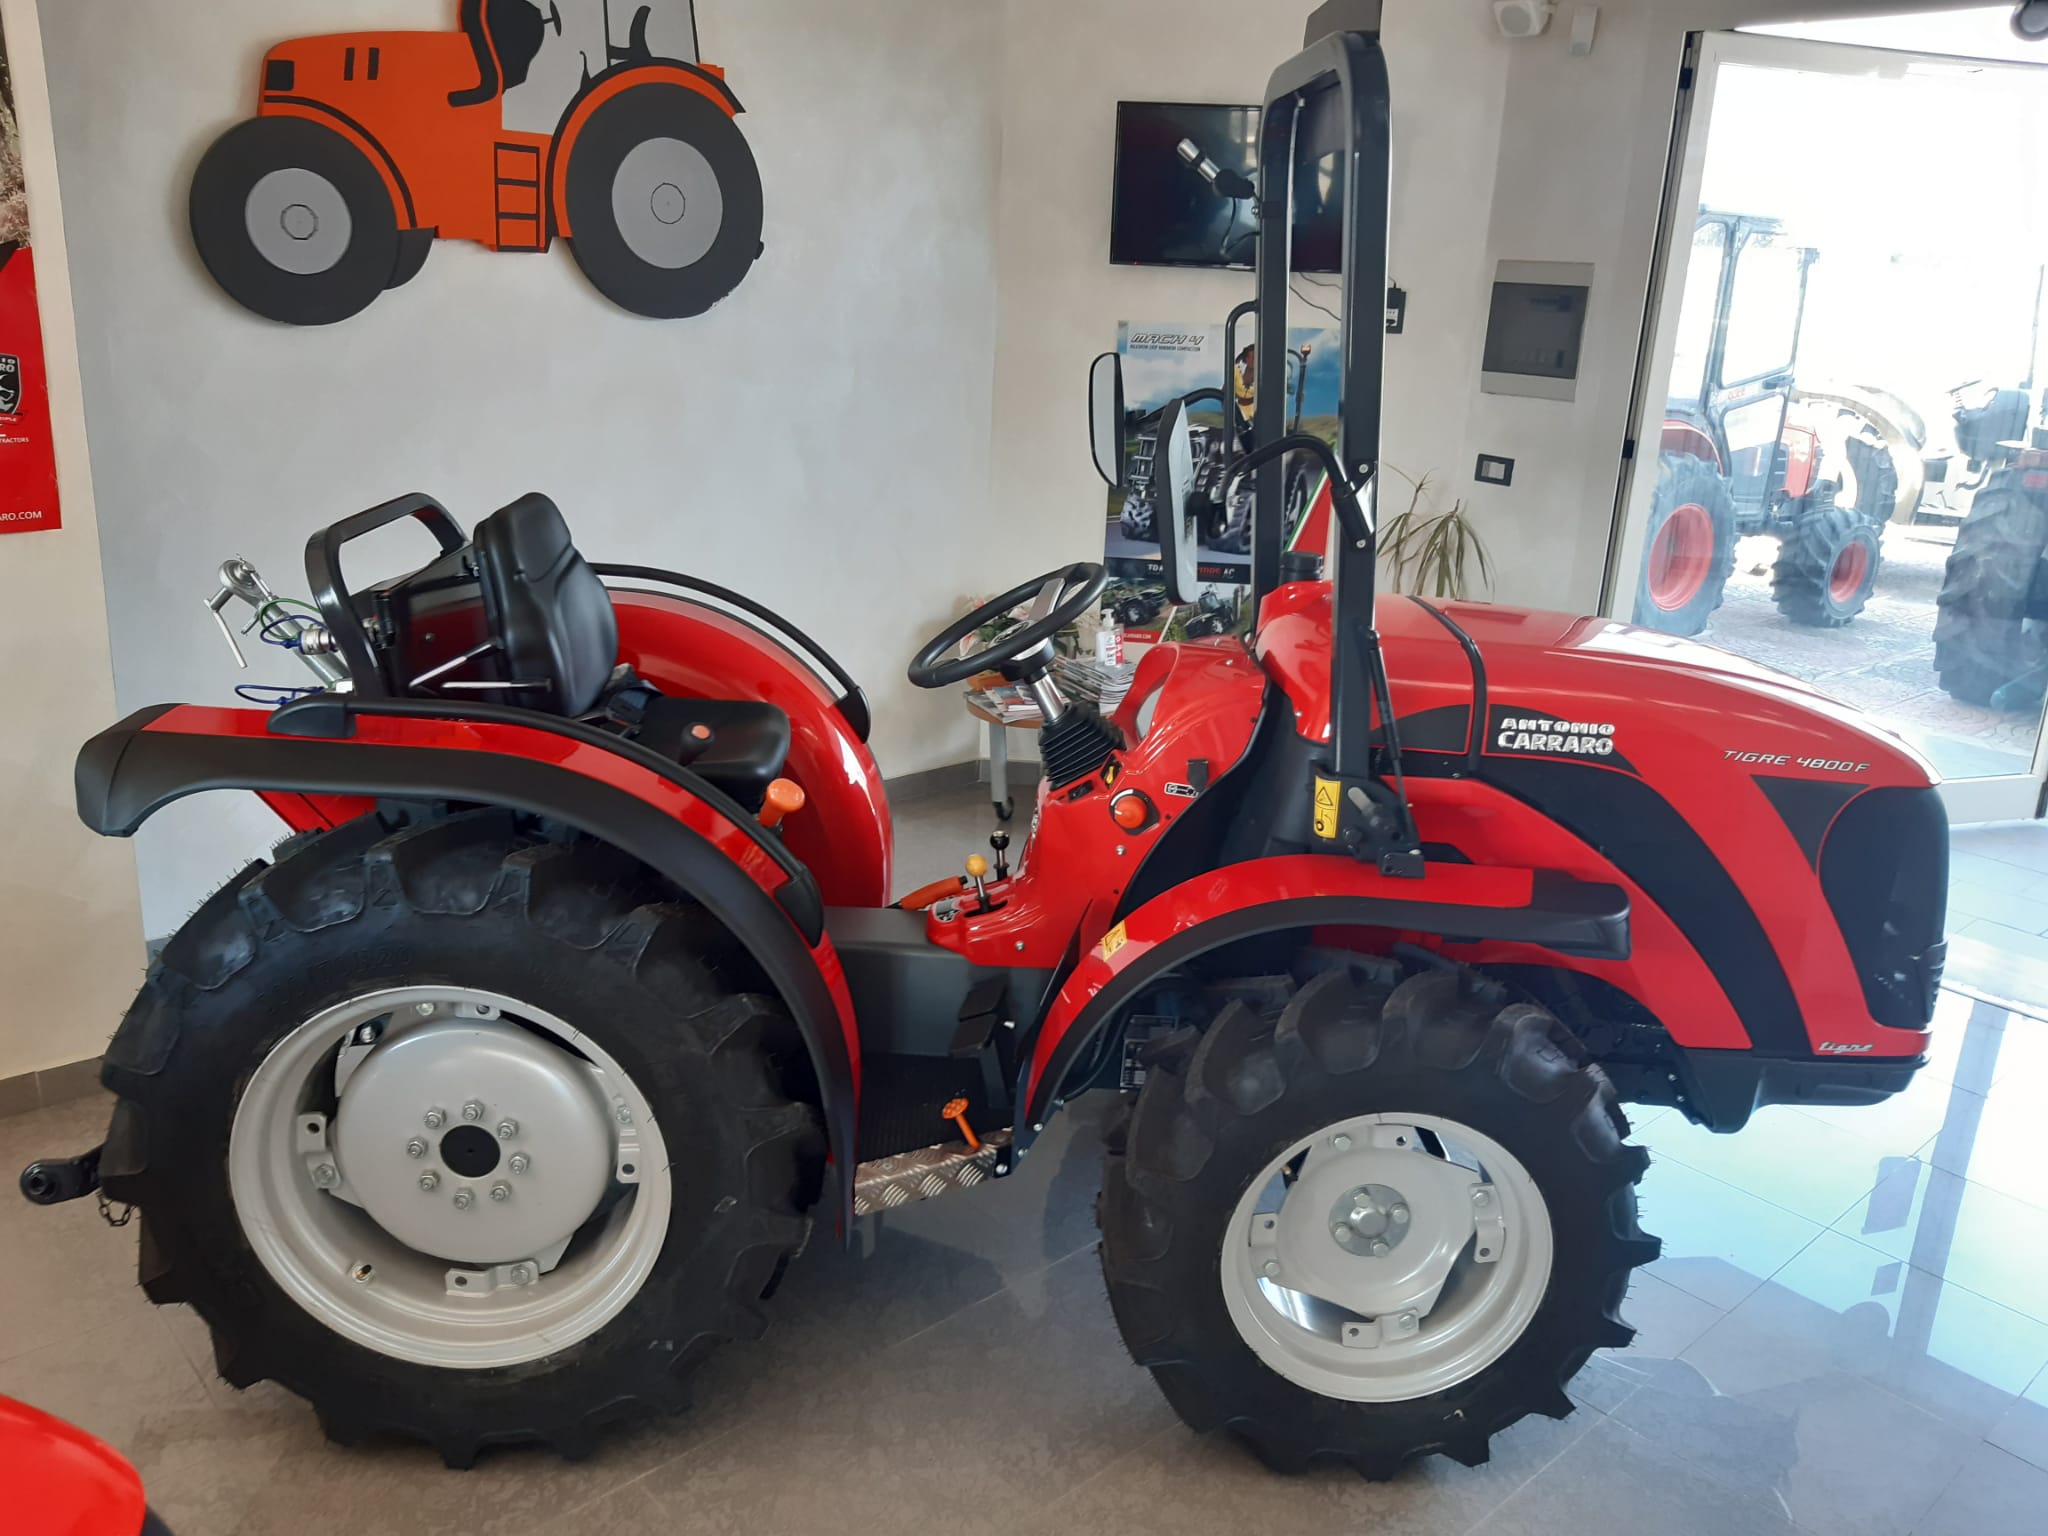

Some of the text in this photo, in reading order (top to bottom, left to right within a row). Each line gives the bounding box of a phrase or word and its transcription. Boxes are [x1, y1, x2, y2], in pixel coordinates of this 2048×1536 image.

[1130, 333, 1205, 346] MACH 4
[0, 510, 42, 522] RO.COM
[1500, 718, 1615, 735] ANTONIO
[1497, 731, 1614, 756] CARRARO
[1723, 750, 1791, 766] TIGRE
